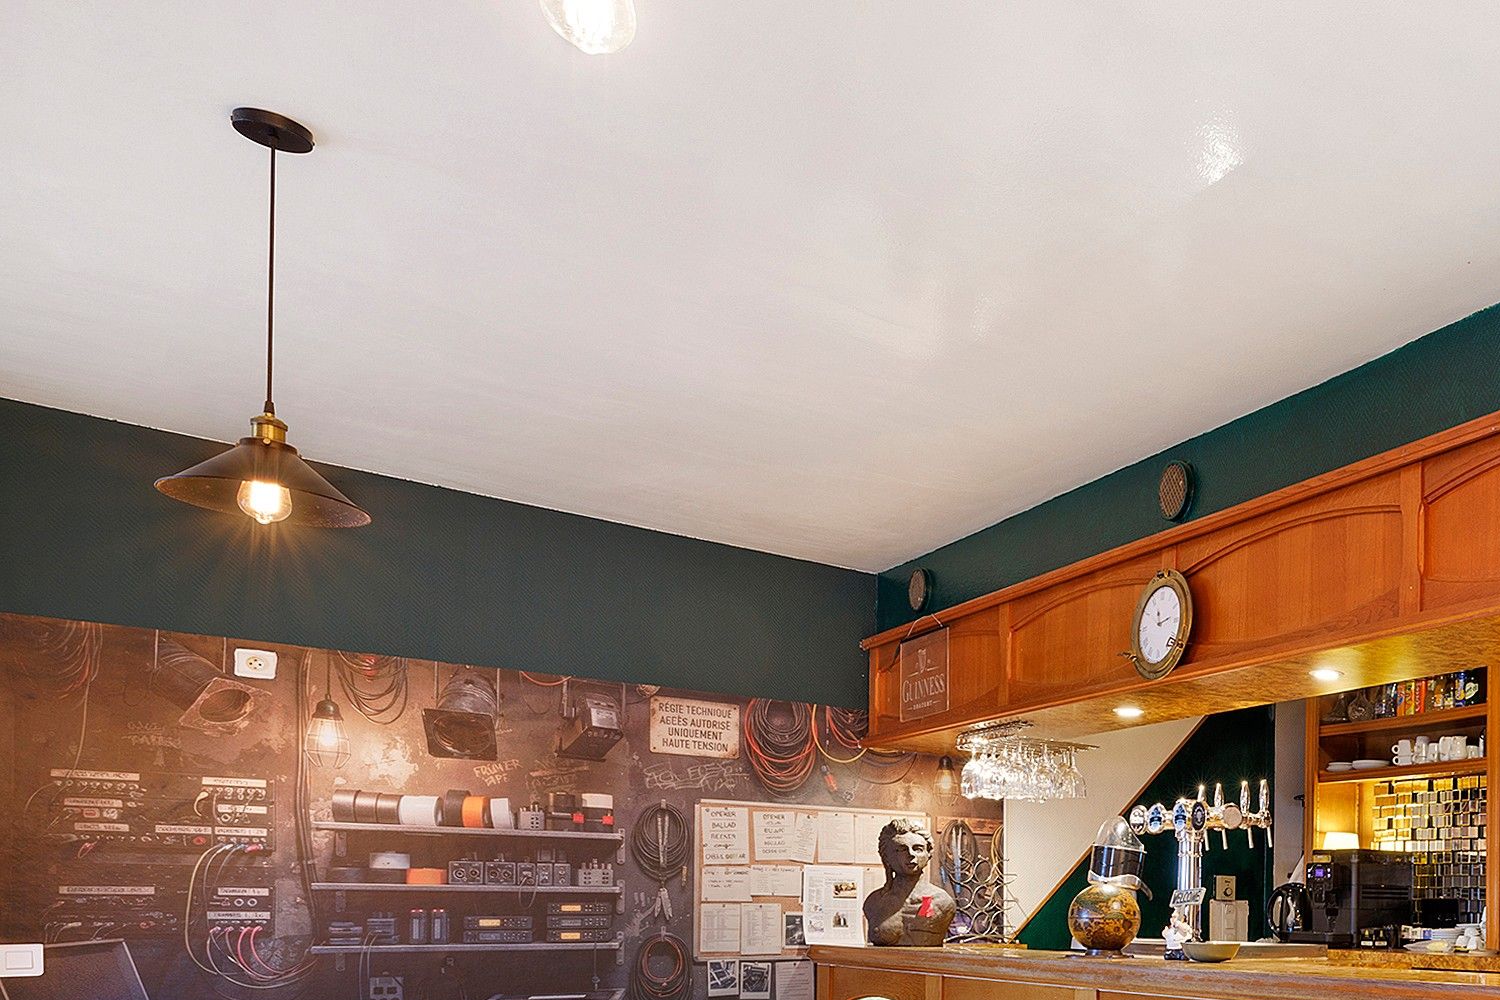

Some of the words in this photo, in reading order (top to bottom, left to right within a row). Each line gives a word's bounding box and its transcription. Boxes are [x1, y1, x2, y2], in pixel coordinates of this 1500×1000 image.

[903, 674, 945, 703] GUINNESS
[686, 705, 732, 719] TECHNIQUE
[668, 727, 723, 741] UNIQUEMENT
[662, 738, 690, 749] HAUTE
[691, 740, 729, 752] TENSION
